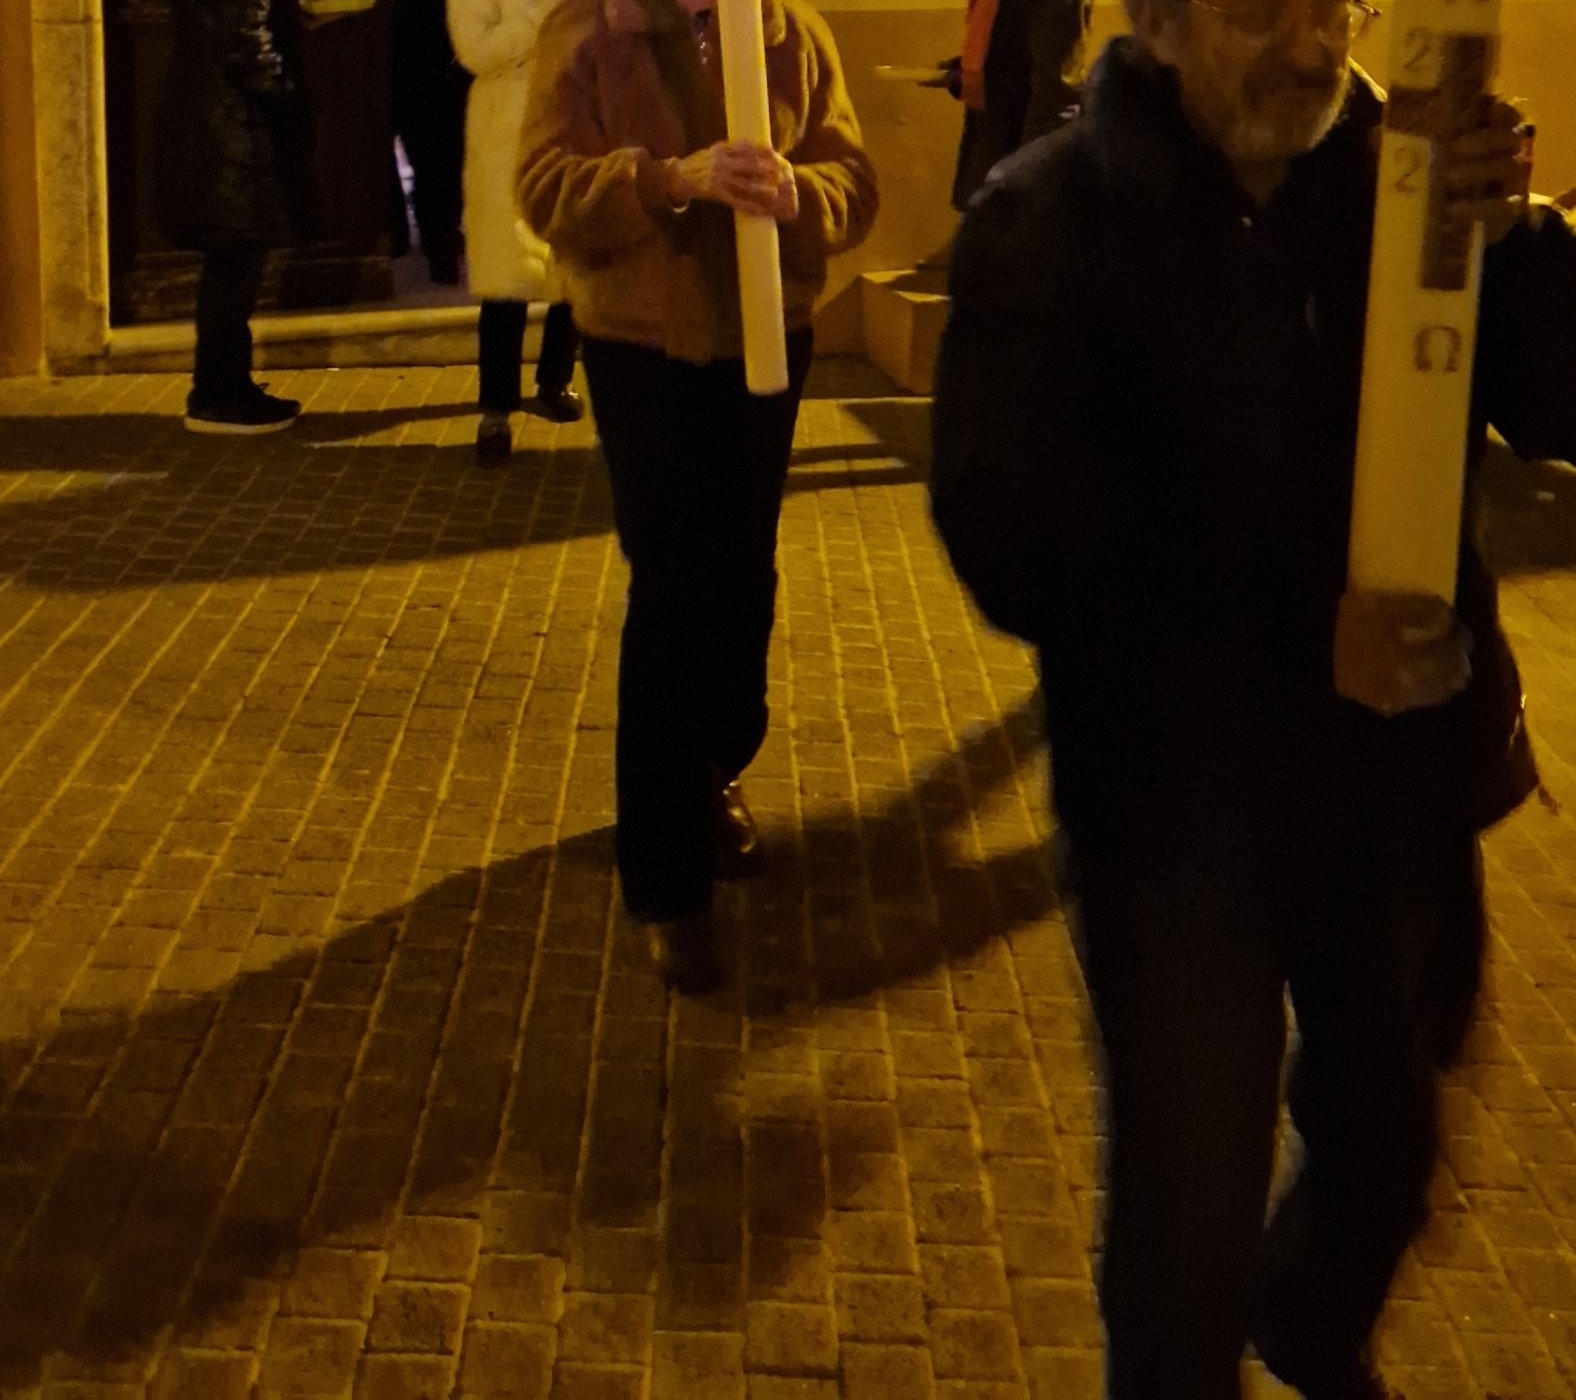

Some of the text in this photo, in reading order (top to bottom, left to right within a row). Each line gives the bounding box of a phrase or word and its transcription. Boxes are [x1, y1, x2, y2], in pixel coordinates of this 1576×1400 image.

[1404, 26, 1433, 71] 2
[1393, 146, 1423, 192] 2
[1413, 325, 1463, 372] Ω
